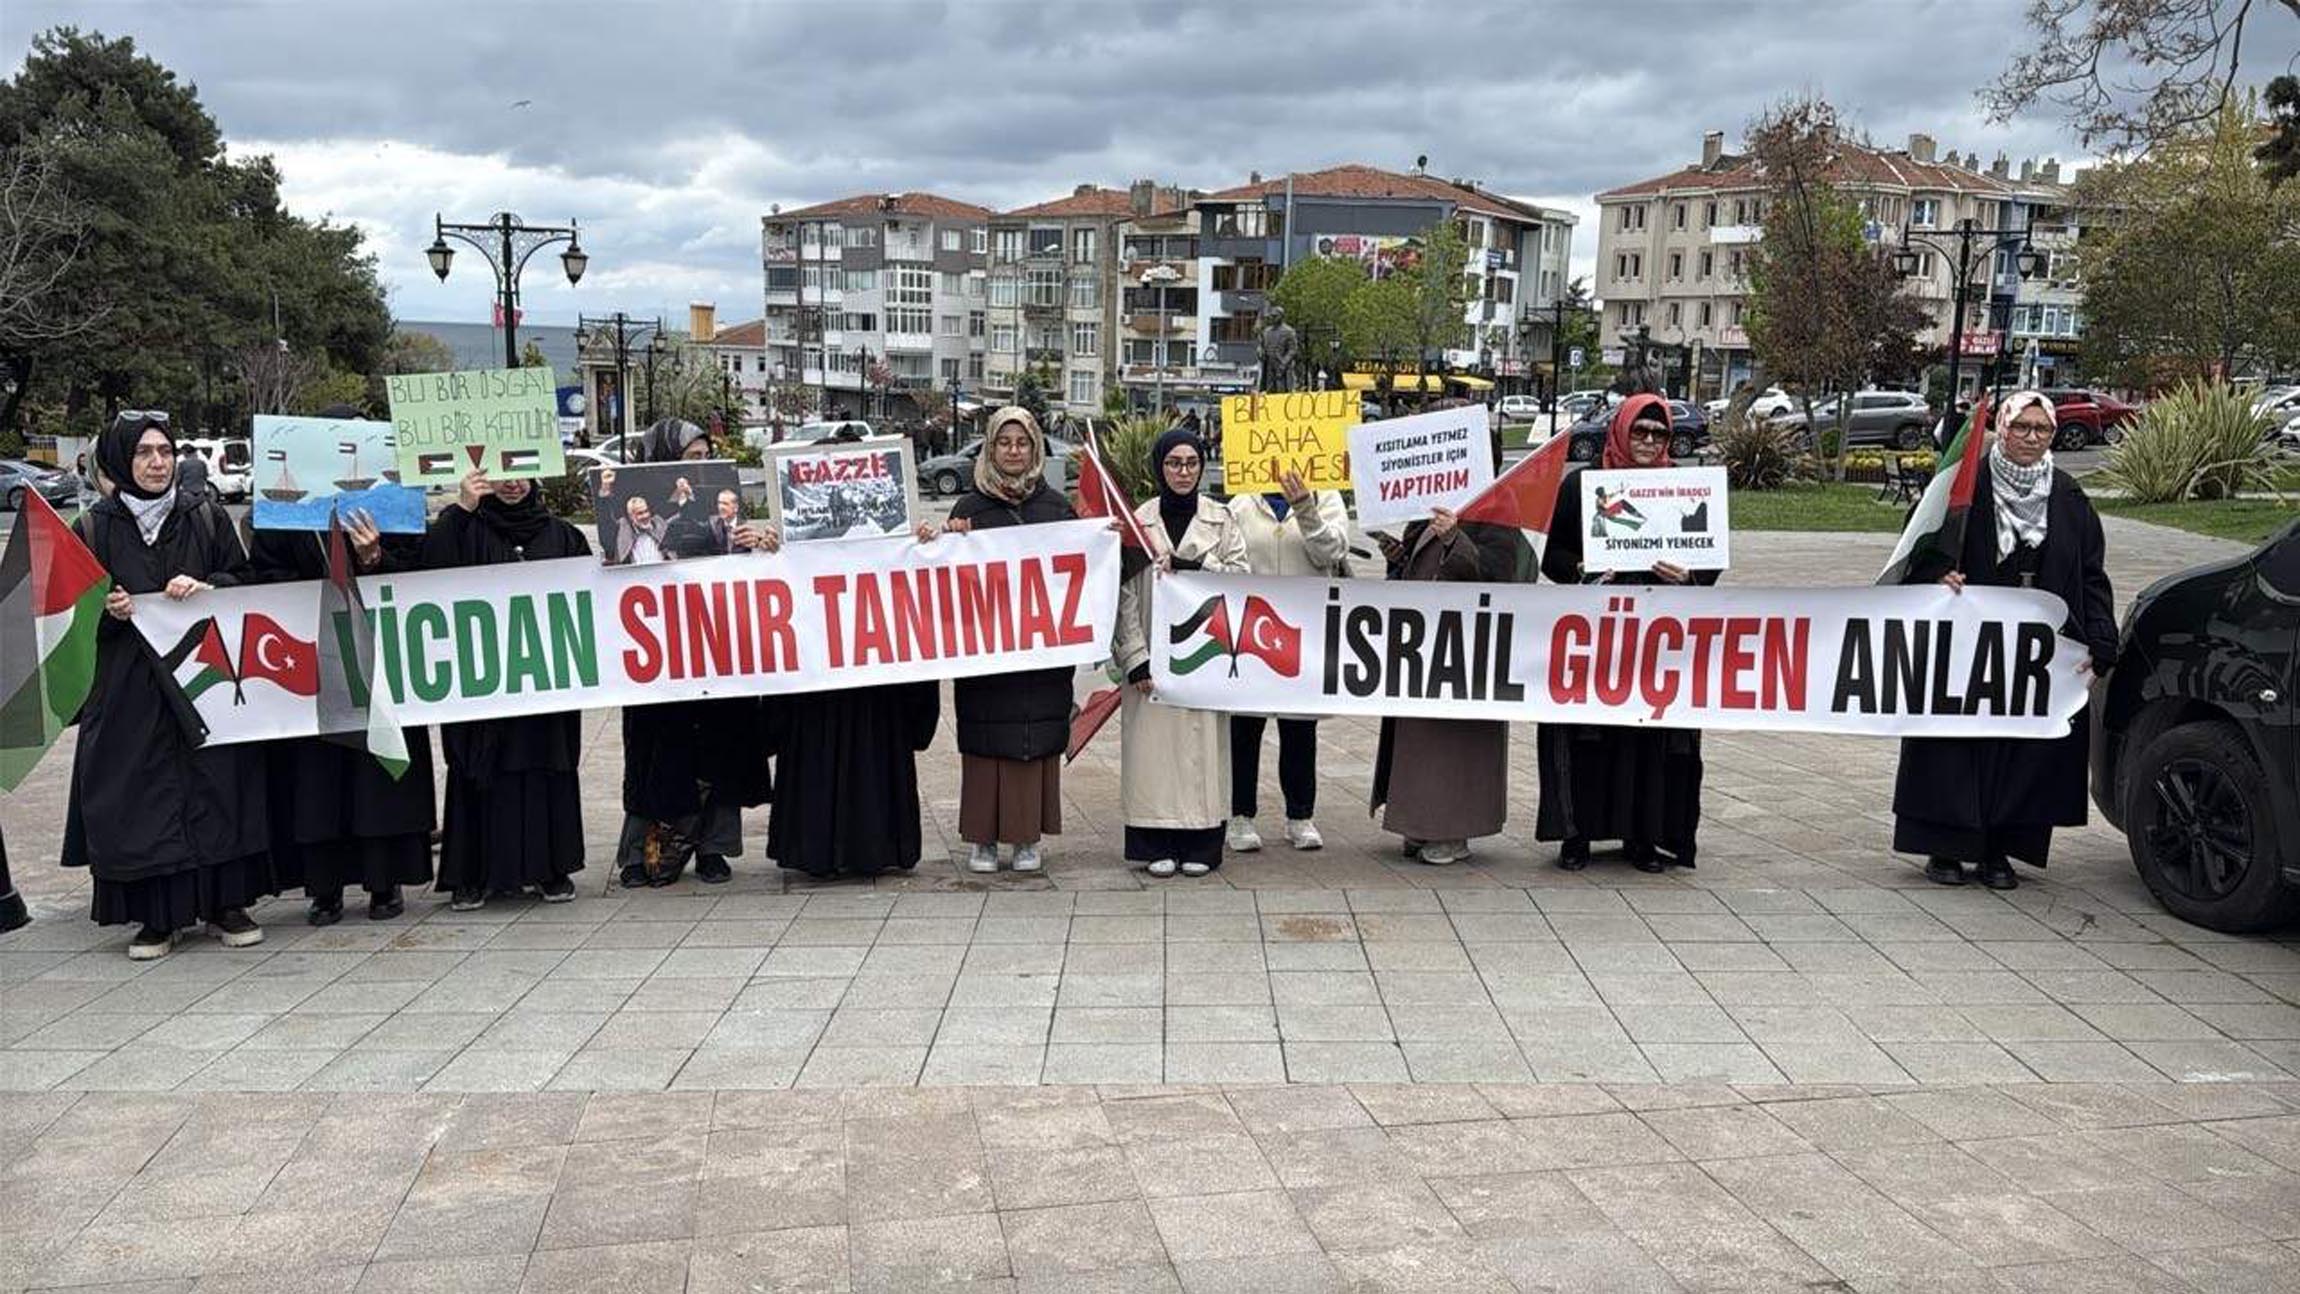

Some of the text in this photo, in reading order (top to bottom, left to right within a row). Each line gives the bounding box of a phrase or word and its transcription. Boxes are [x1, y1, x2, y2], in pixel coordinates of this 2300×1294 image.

[391, 375, 425, 403] BU
[399, 416, 433, 447] BU
[1249, 425, 1323, 454] DAHA
[1376, 428, 1468, 453] KISITLAMA YETMEZ
[789, 453, 889, 484] GAZZE
[1381, 447, 1468, 472] SİYONİSTLER İÇİN
[1380, 468, 1469, 501] YAPTIRIM
[1629, 486, 1675, 498] GAZZE'NİN
[1605, 535, 1715, 551] SİYONİZMİ YENECEK
[332, 553, 1094, 708] VİCDAN SINIR TANIMAZ
[1323, 586, 2056, 719] İSRAİL GÜÇTEN ANLAR
